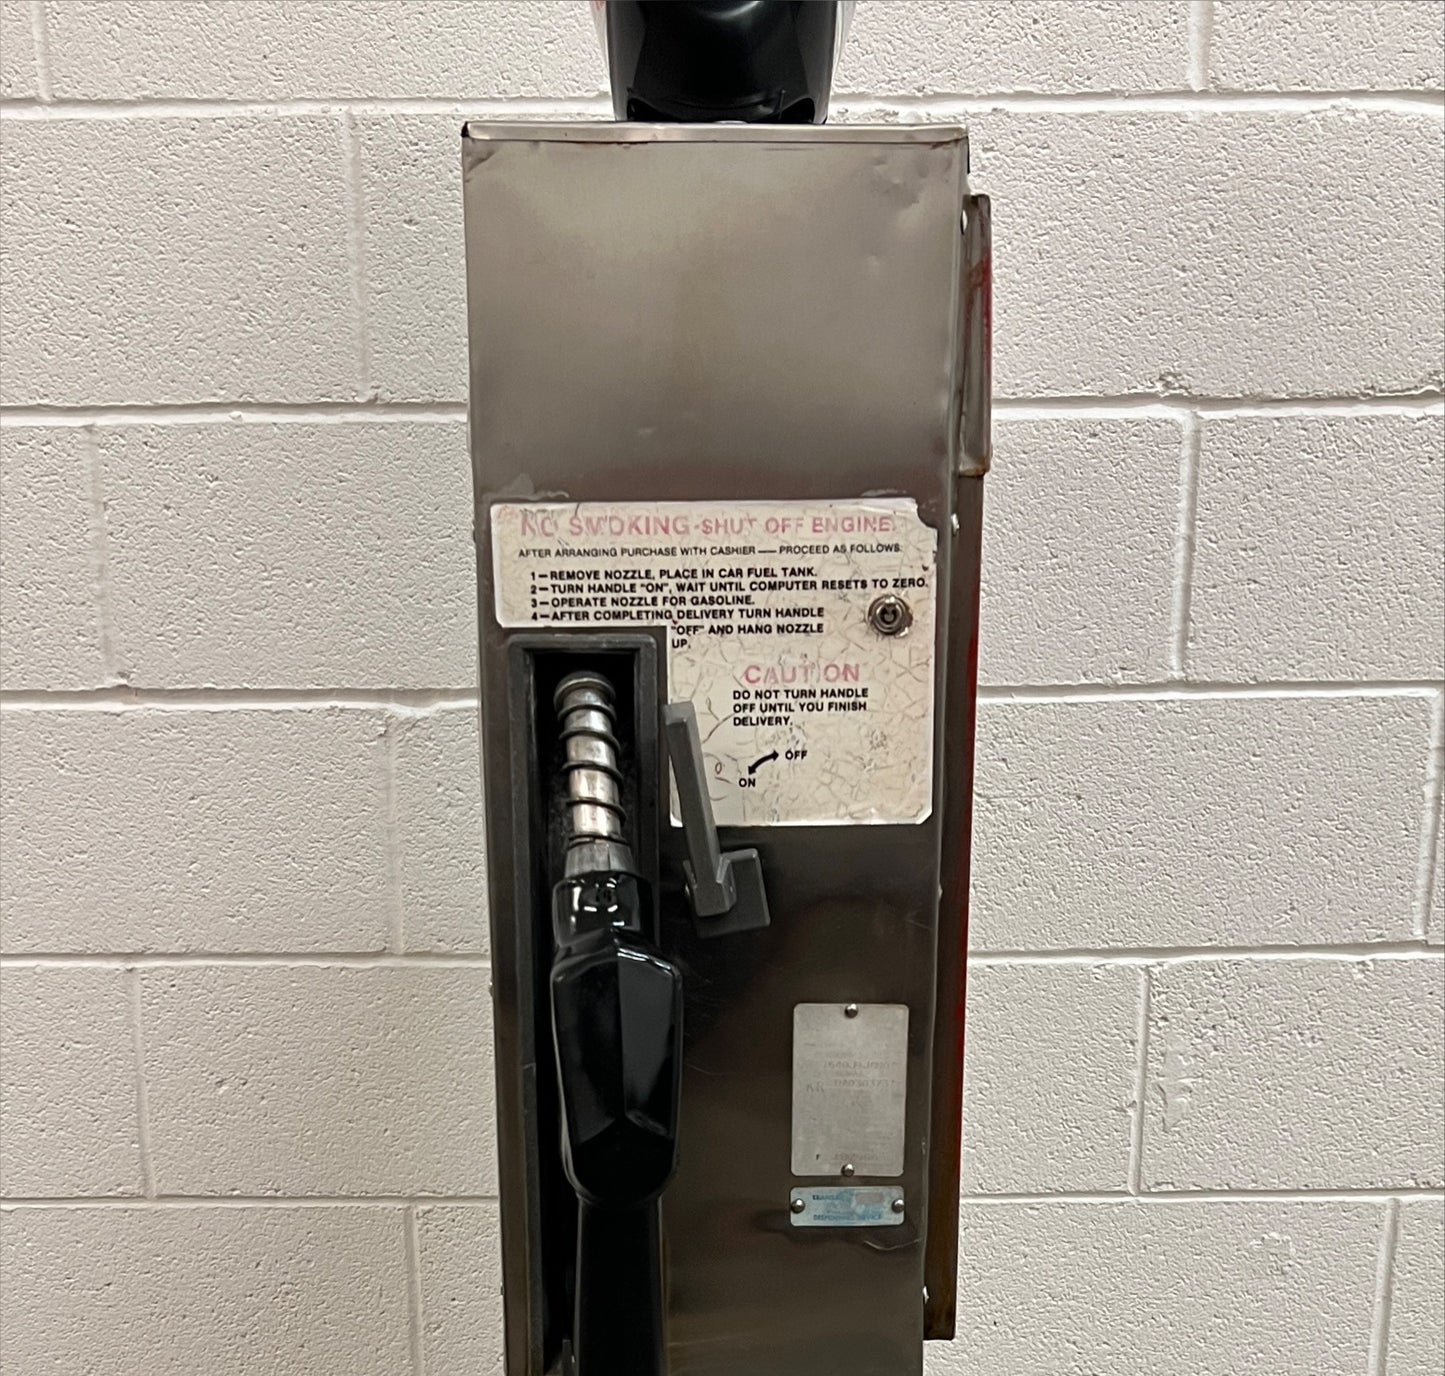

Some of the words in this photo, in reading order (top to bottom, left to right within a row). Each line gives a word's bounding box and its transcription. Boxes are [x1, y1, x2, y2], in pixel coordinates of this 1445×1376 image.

[569, 515, 690, 537] SMOKING
[765, 517, 804, 534] OFF
[518, 549, 551, 558] AFTER
[555, 547, 618, 558] ARRANGING
[621, 547, 677, 557] PURCHASE
[681, 546, 707, 556] WITH
[710, 545, 756, 556] CASHIER
[779, 545, 829, 555] PROCEED
[833, 544, 847, 554] AS
[660, 569, 697, 580] PLACE
[702, 569, 714, 579] IN
[719, 568, 743, 579] CAR
[747, 568, 777, 578] FUEL
[782, 567, 817, 578] TANK.
[588, 583, 636, 594] HANDLE
[676, 582, 705, 593] WAIT
[710, 581, 745, 592] UNTIL
[750, 580, 817, 591] COMPUTER
[822, 579, 867, 590] RESETS
[872, 579, 888, 589] TO
[892, 578, 928, 588] ZERO.
[611, 597, 658, 607] NOZZLE
[663, 596, 686, 607] FOR
[691, 595, 755, 606] GASOLINE.
[594, 610, 673, 621] COMPLETING
[677, 609, 734, 620] DELIVERY
[738, 608, 771, 619] TURN
[776, 607, 824, 618] HANDLE
[708, 624, 734, 635] AND
[738, 624, 772, 635] HANG
[777, 623, 824, 634] NOZZLE
[672, 638, 691, 649] UP.
[733, 690, 750, 700] DO
[755, 690, 779, 700] NOT
[784, 689, 816, 699] TURN
[820, 688, 868, 699] HANDLE
[733, 703, 756, 714] OFF
[760, 702, 795, 713] UNTIL
[799, 702, 824, 712] YOU
[828, 701, 867, 712] FINISH
[733, 716, 793, 727] DELIVERY.
[785, 750, 807, 760] OFF
[738, 778, 756, 788] ON
